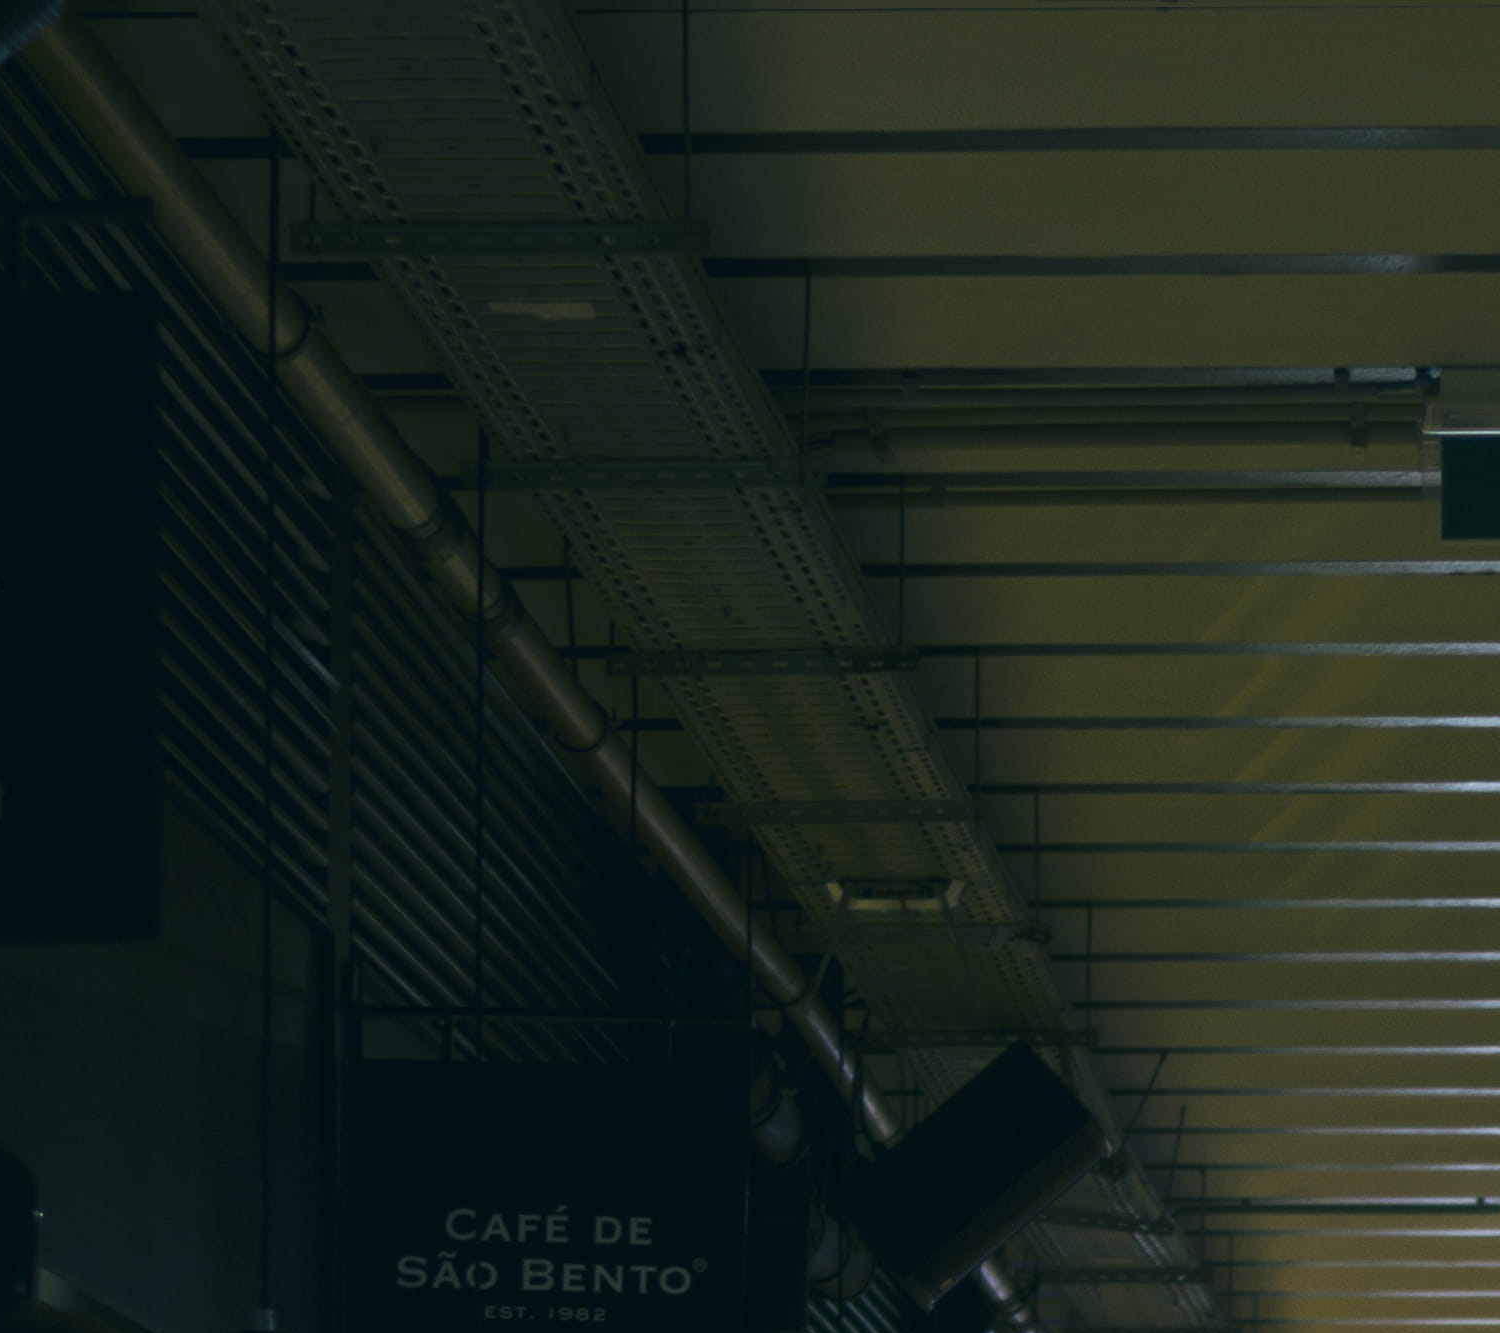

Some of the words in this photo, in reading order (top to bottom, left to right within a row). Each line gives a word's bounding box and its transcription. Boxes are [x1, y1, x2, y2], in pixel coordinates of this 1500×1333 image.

[444, 1204, 570, 1243] CAFÉ
[594, 1214, 653, 1246] DE
[395, 1250, 499, 1290] SÃO
[484, 1305, 536, 1321] EST.
[549, 1307, 607, 1322] 1982
